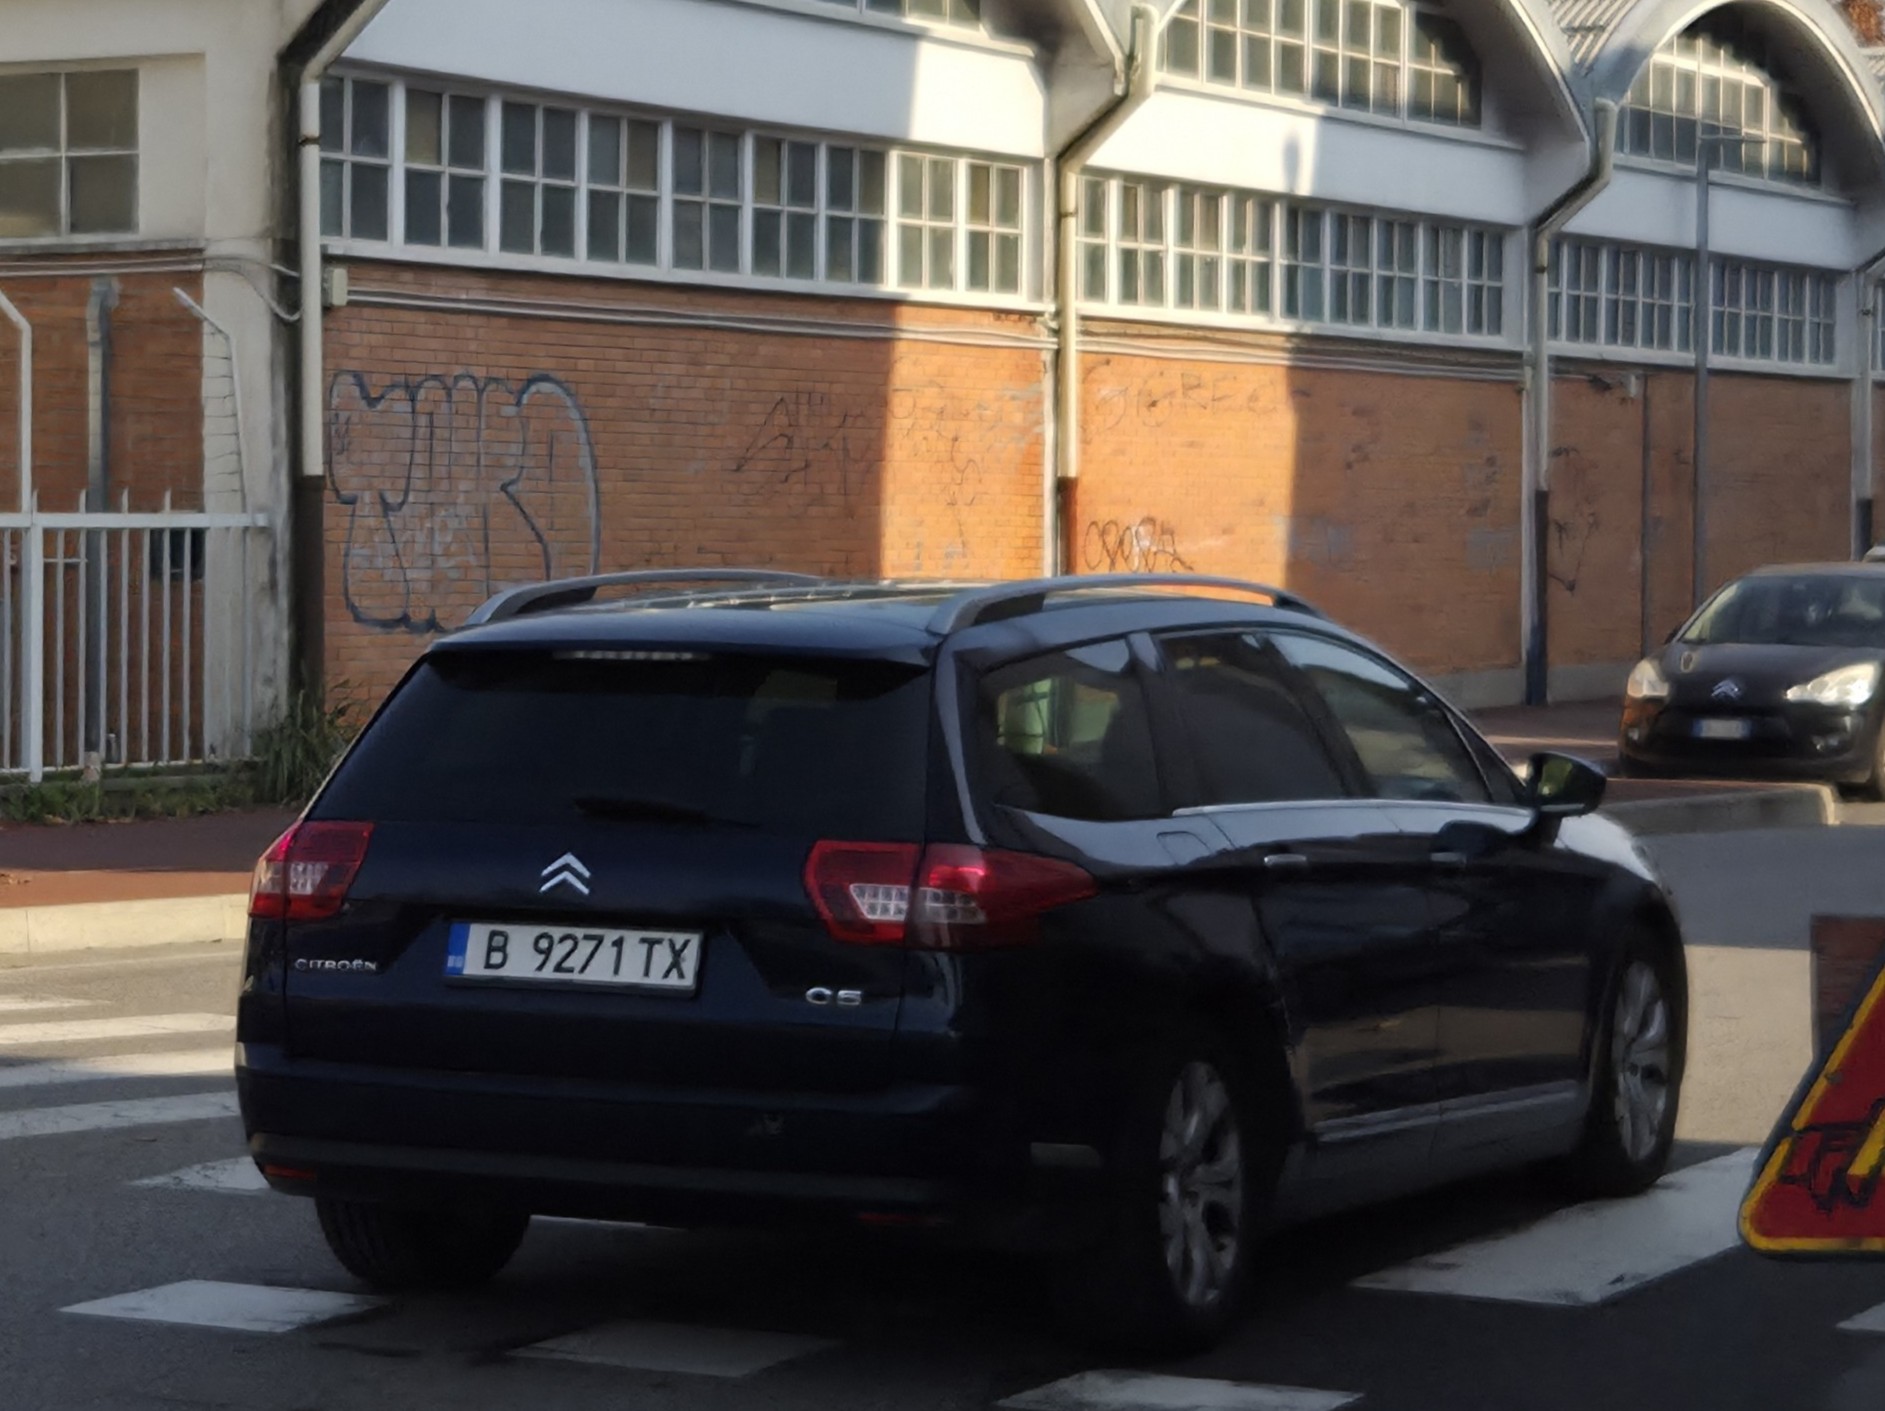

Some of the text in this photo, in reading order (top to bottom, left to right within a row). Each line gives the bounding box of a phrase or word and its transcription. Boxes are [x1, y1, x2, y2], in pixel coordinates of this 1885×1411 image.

[484, 929, 692, 980] B 9271 TX
[805, 987, 863, 1006] C5
